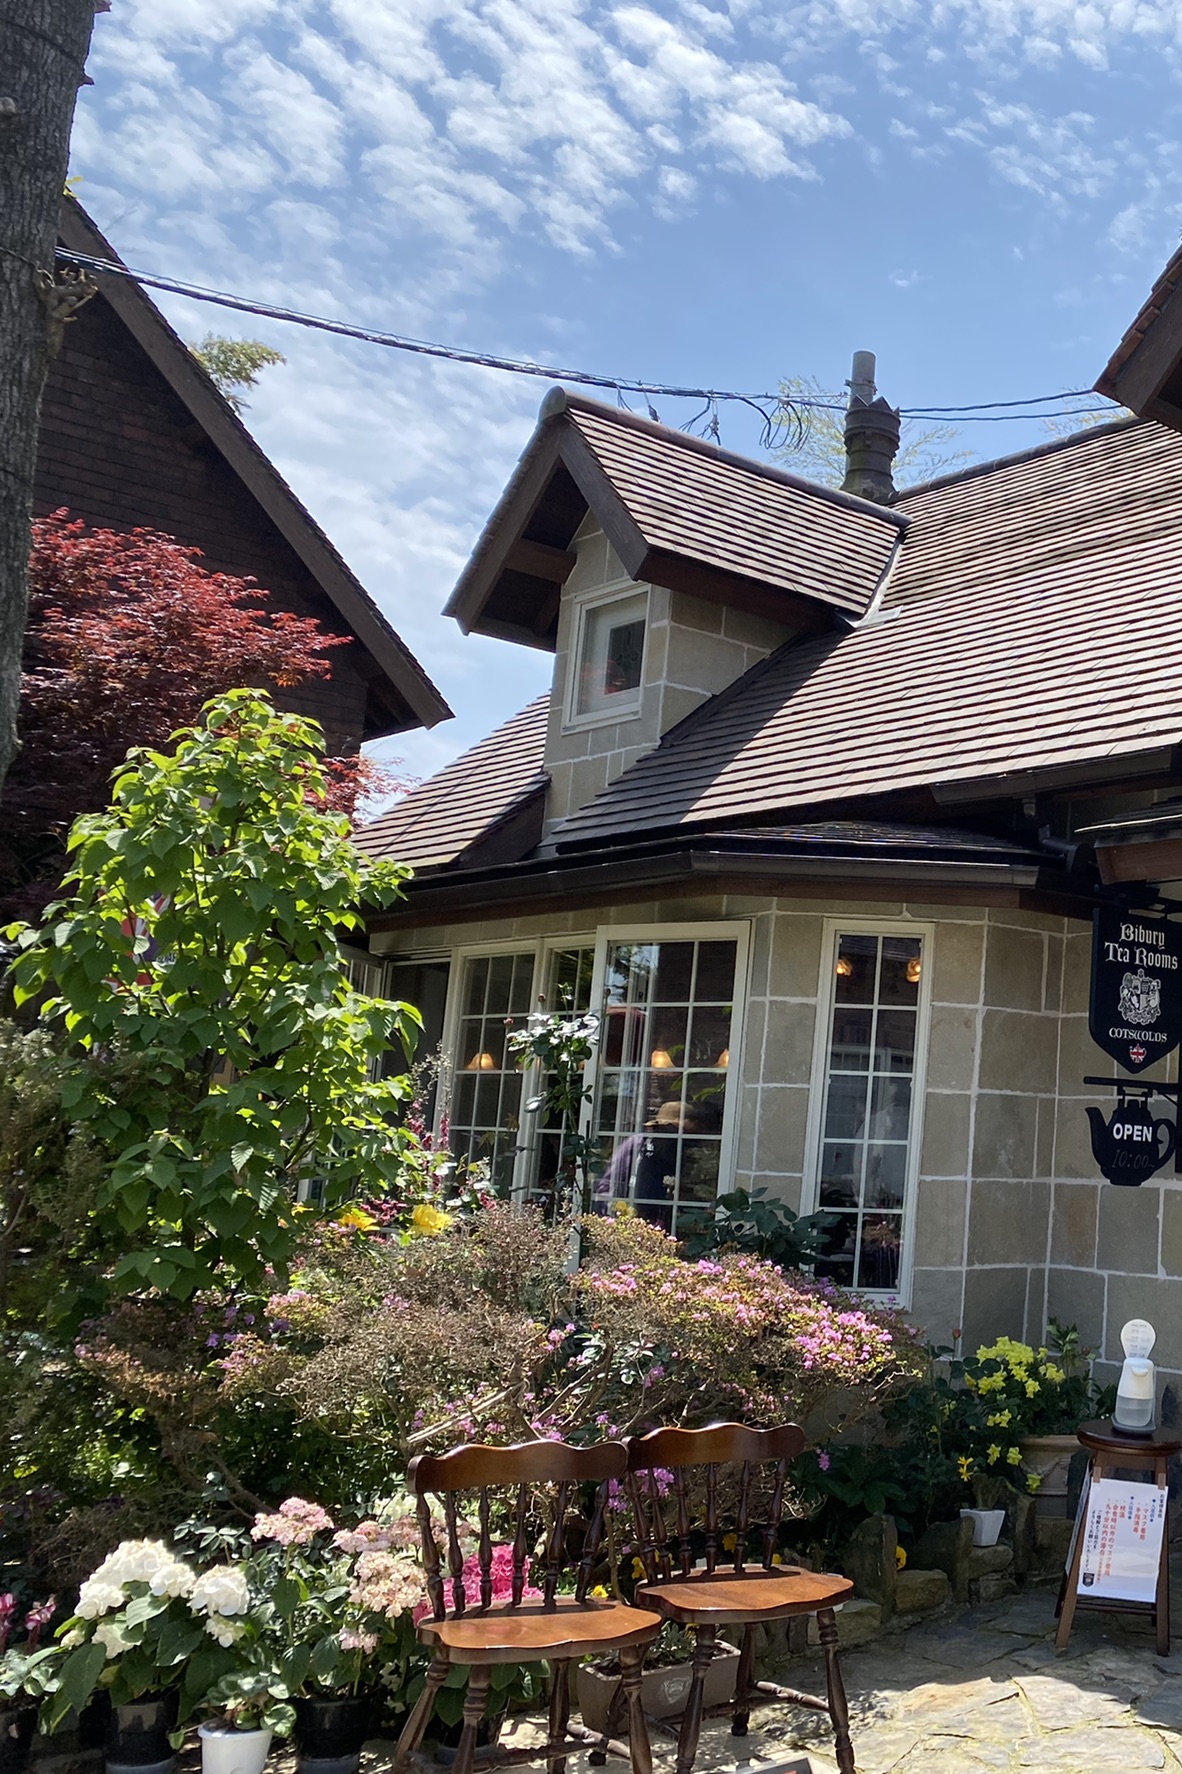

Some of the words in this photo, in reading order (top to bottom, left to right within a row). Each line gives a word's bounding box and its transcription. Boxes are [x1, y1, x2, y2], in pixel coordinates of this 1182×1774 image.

[1119, 922, 1165, 950] Bibury
[1104, 941, 1130, 963] Tea
[1133, 946, 1178, 970] Rooms
[1108, 1027, 1168, 1043] COTSWOLDS
[1112, 1122, 1153, 1142] OPEN
